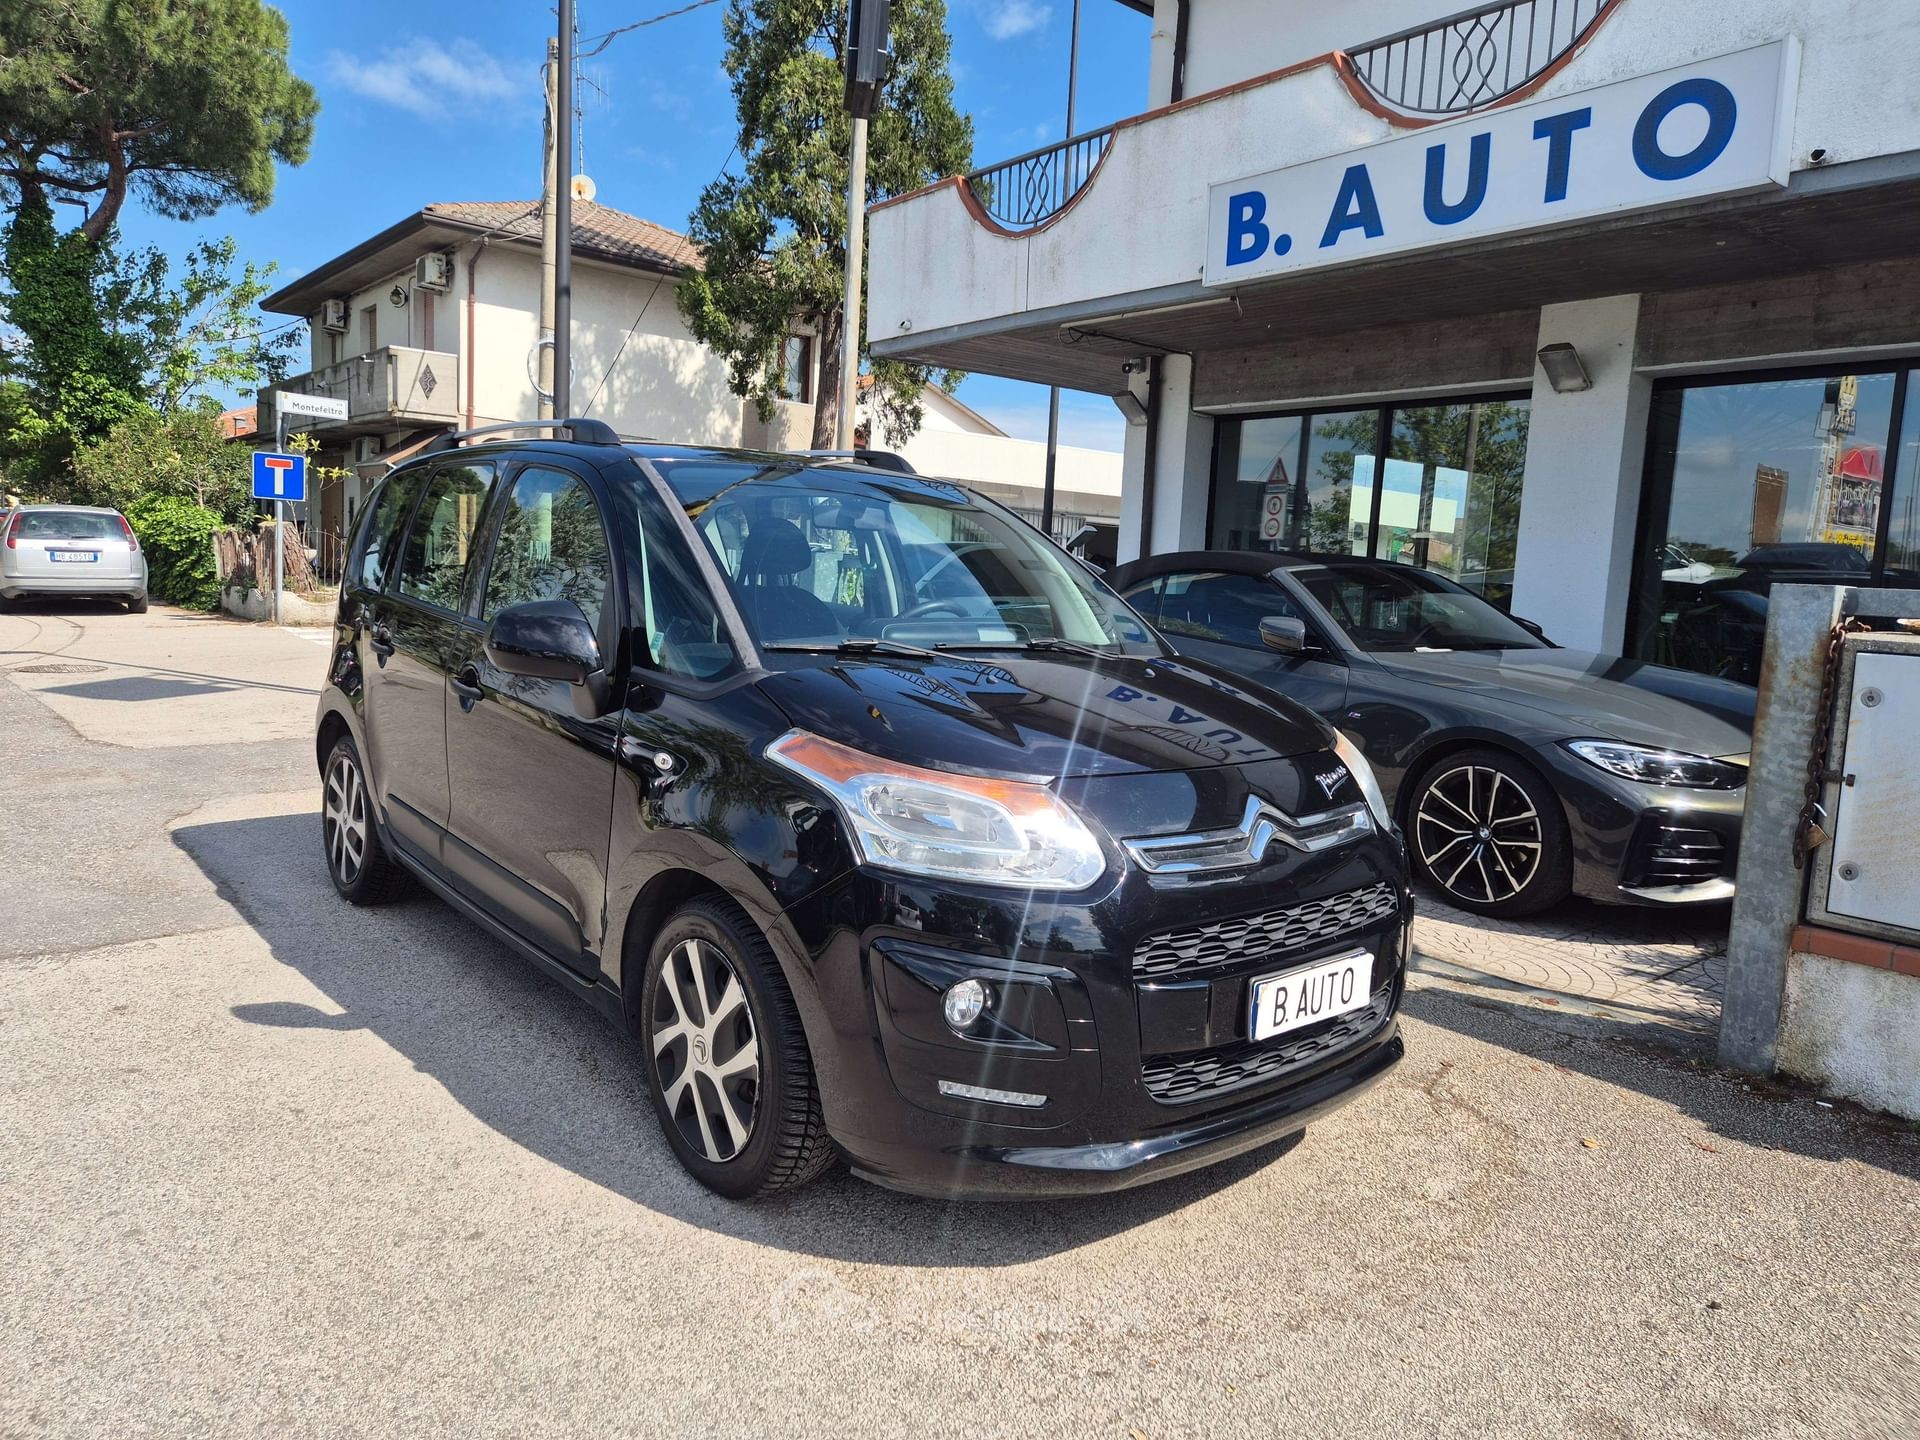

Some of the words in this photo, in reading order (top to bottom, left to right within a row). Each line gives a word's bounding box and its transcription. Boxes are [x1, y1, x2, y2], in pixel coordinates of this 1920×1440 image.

[1226, 189, 1291, 266] B.
[1318, 78, 1737, 248] AUTO
[292, 402, 343, 416] Montefeltro
[1295, 967, 1354, 1020] AUTO
